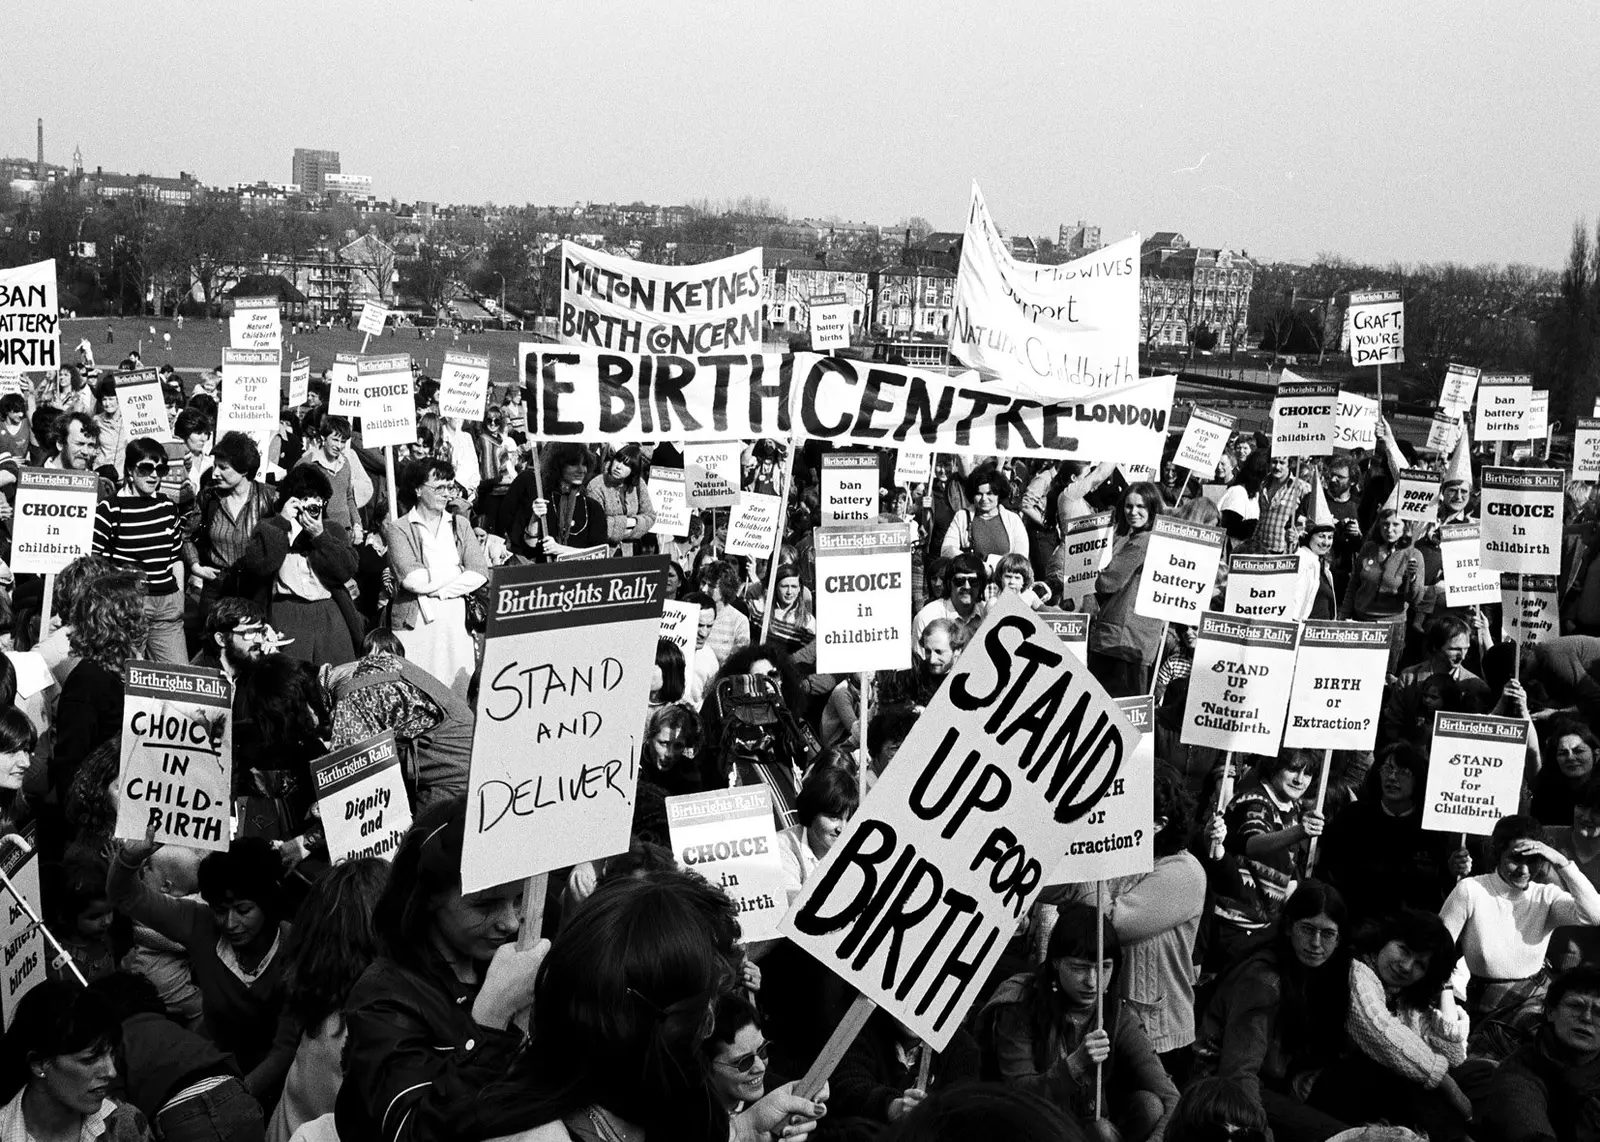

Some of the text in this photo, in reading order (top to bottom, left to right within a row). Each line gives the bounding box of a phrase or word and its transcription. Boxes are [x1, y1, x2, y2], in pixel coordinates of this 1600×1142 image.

[564, 257, 761, 314] MILTON KEYNES
[251, 314, 267, 322] Save
[1354, 310, 1402, 330] CRAFT,
[246, 322, 273, 331] Natural
[561, 301, 760, 354] BIRTH CONCERN
[816, 323, 845, 331] battery
[241, 331, 277, 339] Childbirth
[820, 334, 843, 342] births
[1356, 332, 1400, 347] YOU'RE
[1358, 346, 1401, 363] DAFT
[235, 376, 268, 385] STAND
[453, 371, 481, 382] Dignity
[245, 385, 258, 393] UP
[364, 384, 409, 399] CHOICE
[447, 387, 481, 400] Humanity
[597, 352, 796, 434] BIRTH
[1278, 385, 1336, 395] Birthrights Rally
[127, 393, 153, 404] STAND
[1494, 396, 1515, 405] ban
[231, 403, 266, 411] Natural
[383, 403, 393, 413] in
[443, 405, 480, 416] Childbirth
[1279, 405, 1332, 416] CHOICE
[1484, 409, 1524, 419] battery
[130, 418, 157, 428] Natural
[366, 417, 410, 431] childbirth
[1075, 403, 1167, 433] LONDON
[1298, 421, 1309, 429] in
[1194, 427, 1220, 440] STAND
[1486, 422, 1520, 431] births
[1277, 433, 1326, 443] childbirth
[1342, 427, 1374, 443] SKILL
[696, 454, 728, 464] STAND
[1185, 446, 1211, 458] Natural
[21, 472, 95, 488] Birthrights Rally
[694, 480, 728, 489] Natural
[840, 481, 862, 490] ban
[1484, 473, 1560, 487] Birthrights Rally
[830, 495, 873, 507] battery
[1403, 490, 1435, 502] BORN
[22, 503, 88, 519] CHOICE
[748, 504, 765, 513] Save
[1401, 502, 1428, 513] FREE
[1487, 502, 1555, 518] CHOICE
[741, 513, 770, 523] Natural
[833, 511, 869, 520] births
[46, 525, 60, 536] in
[734, 521, 772, 533] Childbirth
[1155, 520, 1222, 544] Birthrights Rally
[1512, 524, 1526, 536] in
[744, 531, 762, 539] from
[819, 532, 907, 548] Birthrights Rally
[18, 543, 82, 555] childbirth
[732, 539, 770, 550] Extinction
[1068, 538, 1108, 555] CHOICE
[1486, 541, 1551, 555] childbirth
[1083, 558, 1092, 566] in
[1169, 554, 1197, 570] ban
[1232, 560, 1296, 571] Birthrights Rally
[1456, 559, 1480, 569] BIRT
[825, 572, 902, 593] CHOICE
[1152, 570, 1206, 594] battery
[1449, 581, 1500, 594] Extraction?
[495, 576, 658, 614] Birthrights Rally
[1250, 588, 1276, 598] ban
[1153, 591, 1197, 611] births
[857, 603, 873, 618] in
[1235, 604, 1287, 616] battery
[1523, 609, 1540, 617] and
[1053, 622, 1083, 636] Rally
[1511, 617, 1553, 631] Hmanity
[825, 626, 899, 645] childbirth
[1203, 620, 1292, 644] Birthrights Rally
[1304, 628, 1387, 644] Birthrights Rally
[1527, 631, 1537, 639] in
[1211, 660, 1270, 676] STAND
[129, 670, 227, 698] Birthrights Rally
[1227, 675, 1248, 688] UP
[1313, 677, 1361, 691] BIRTH
[486, 657, 623, 722] STAND
[1223, 690, 1246, 704] for
[1326, 698, 1341, 708] or
[1201, 702, 1259, 720] Natural
[536, 711, 603, 743] AND
[949, 615, 1124, 825] STAND
[1292, 716, 1370, 731] Extraction?
[1438, 719, 1524, 738] Birthrights Rally
[162, 753, 190, 777] IN
[316, 742, 395, 788] Birthrights Rally
[1448, 753, 1503, 768] STAND
[1463, 767, 1483, 778] UP
[477, 734, 634, 834] DELIVER!
[1460, 780, 1482, 791] for
[126, 778, 224, 811] CHILD-
[1440, 791, 1495, 806] Natural
[345, 787, 391, 820] Dignity
[671, 797, 732, 818] Birthrights
[148, 807, 222, 842] BIRTH
[360, 809, 383, 837] and
[909, 726, 1042, 919] UP FOR
[682, 835, 769, 865] CHOICE
[720, 872, 739, 887] in
[794, 818, 1000, 1033] BIRTH
[9, 951, 38, 996] births
